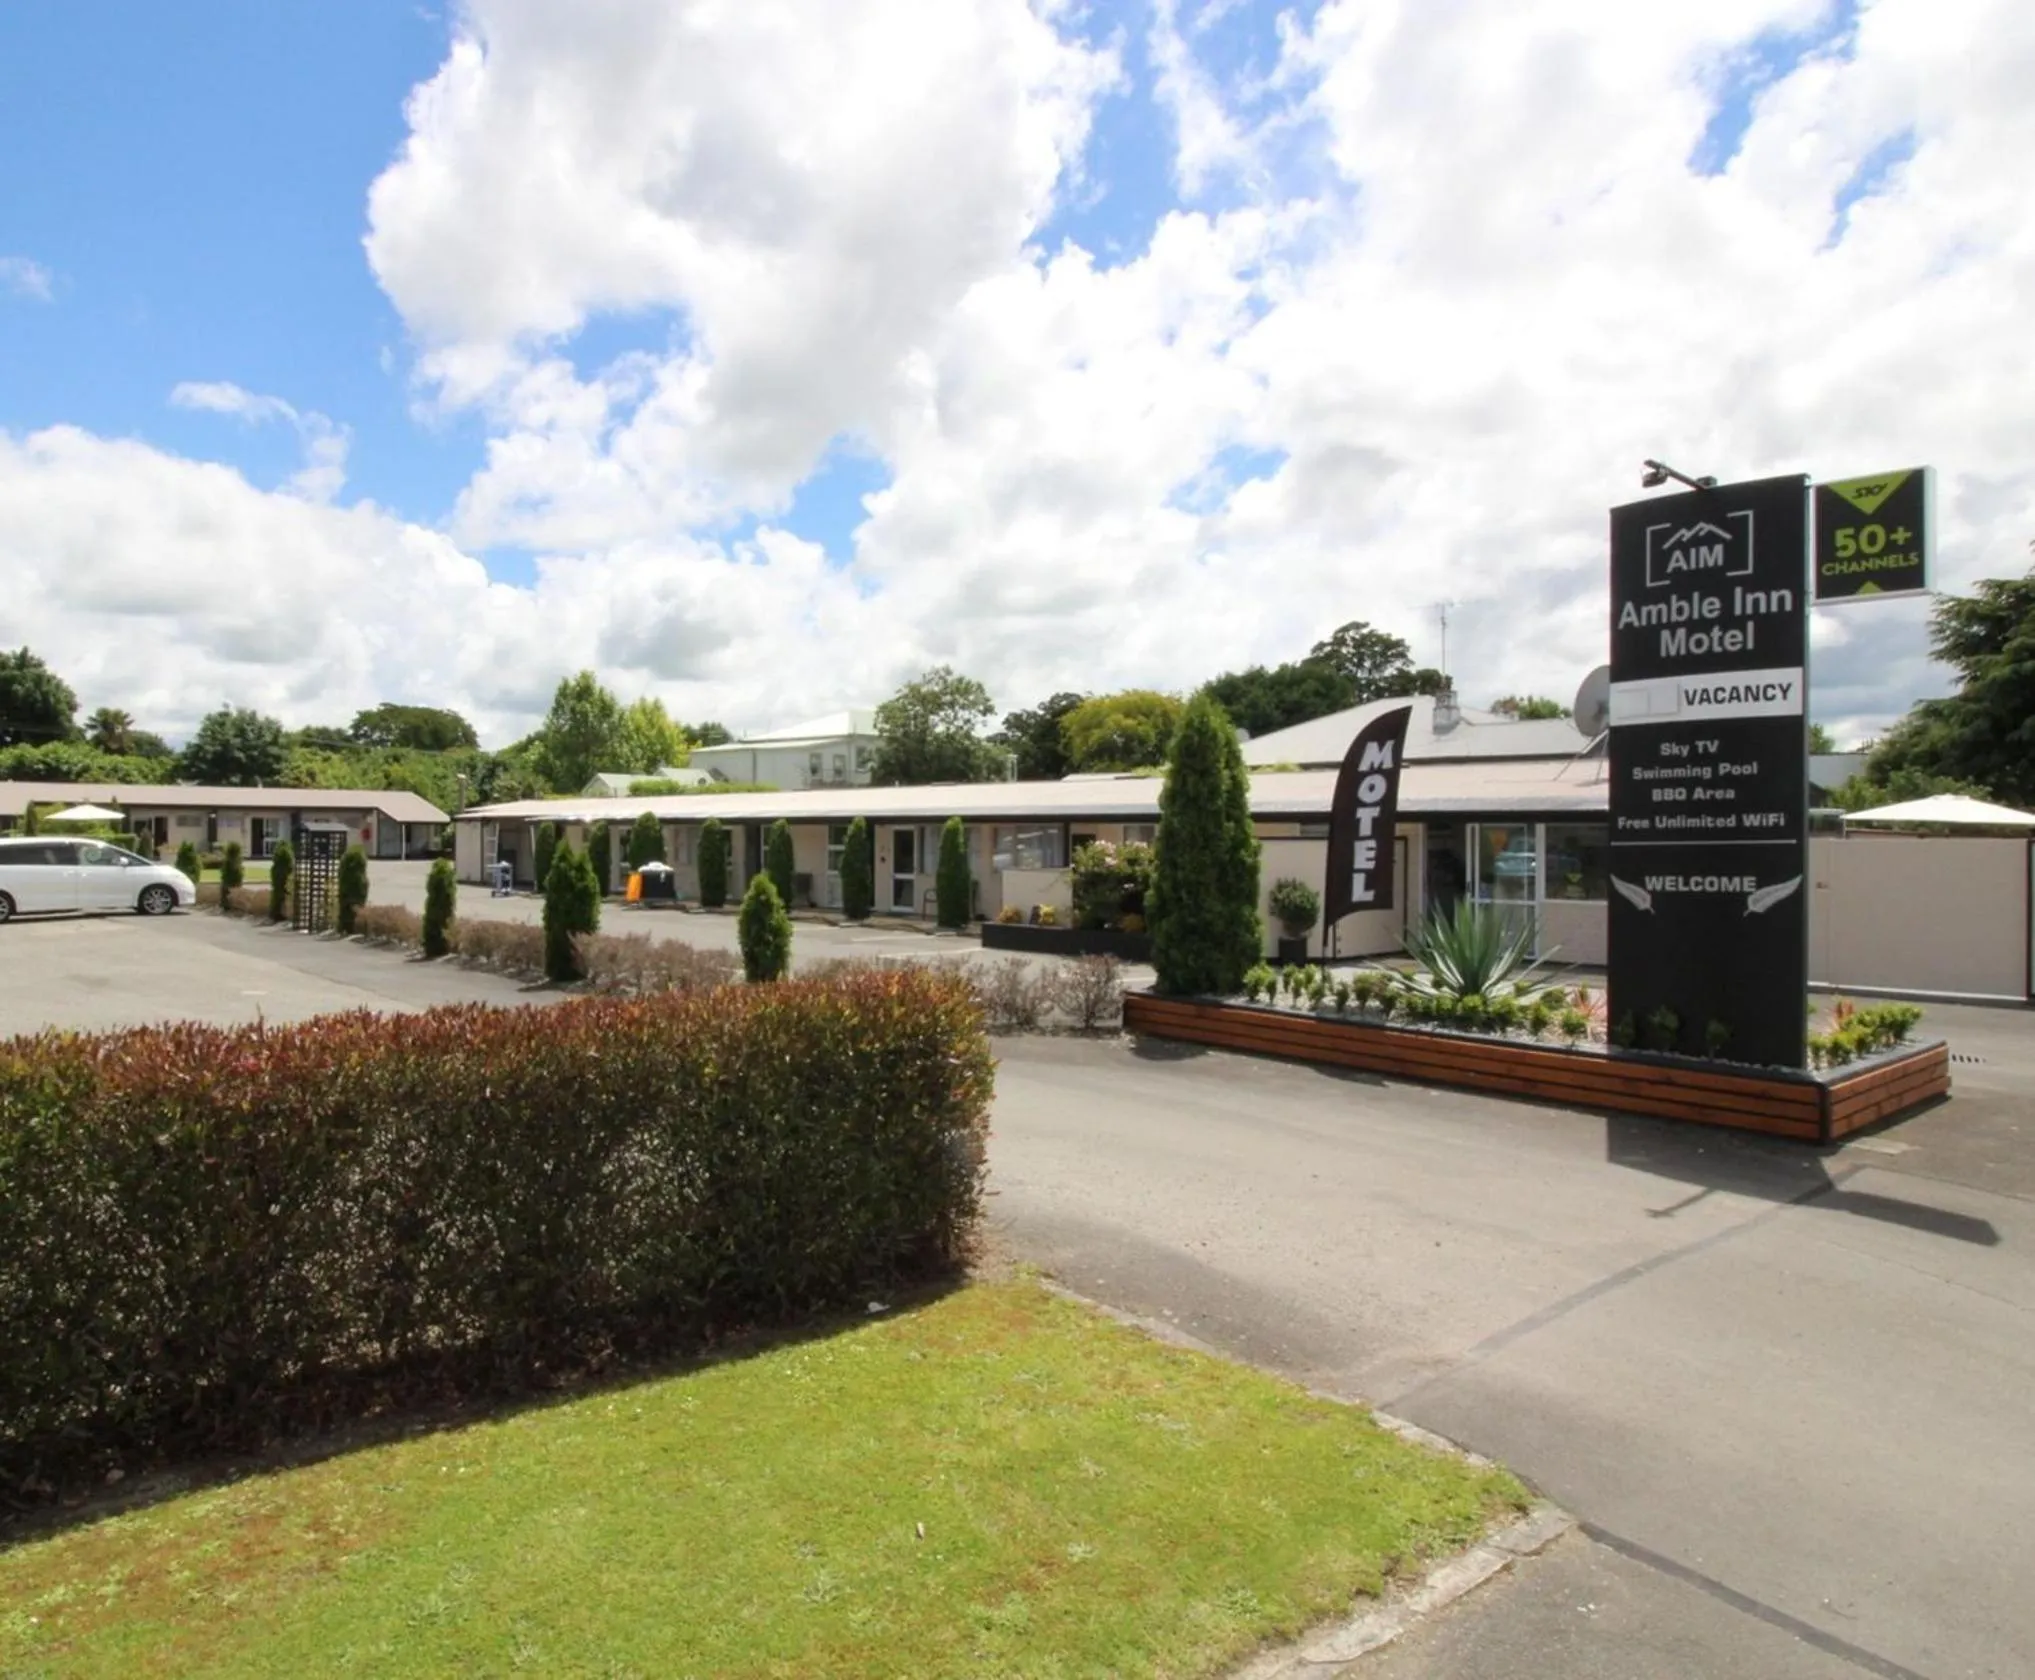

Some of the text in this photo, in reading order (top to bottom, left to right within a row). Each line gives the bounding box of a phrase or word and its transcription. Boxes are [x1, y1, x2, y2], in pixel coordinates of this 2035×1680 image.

[1835, 523, 1912, 558] 50+
[1666, 544, 1724, 573] AIM
[1821, 552, 1919, 576] CHANNELS
[1618, 586, 1793, 630] Amble Inn
[1660, 621, 1755, 658] Motel
[1684, 682, 1792, 707] VACANCY
[1660, 740, 1720, 758] Sky TV
[1632, 761, 1758, 780] Swimming Pool
[1652, 786, 1736, 802] BBQ Area
[1351, 739, 1395, 903] MOTEL
[1617, 812, 1786, 830] Free Unlimited WiFi
[1644, 875, 1757, 893] WELCOME
